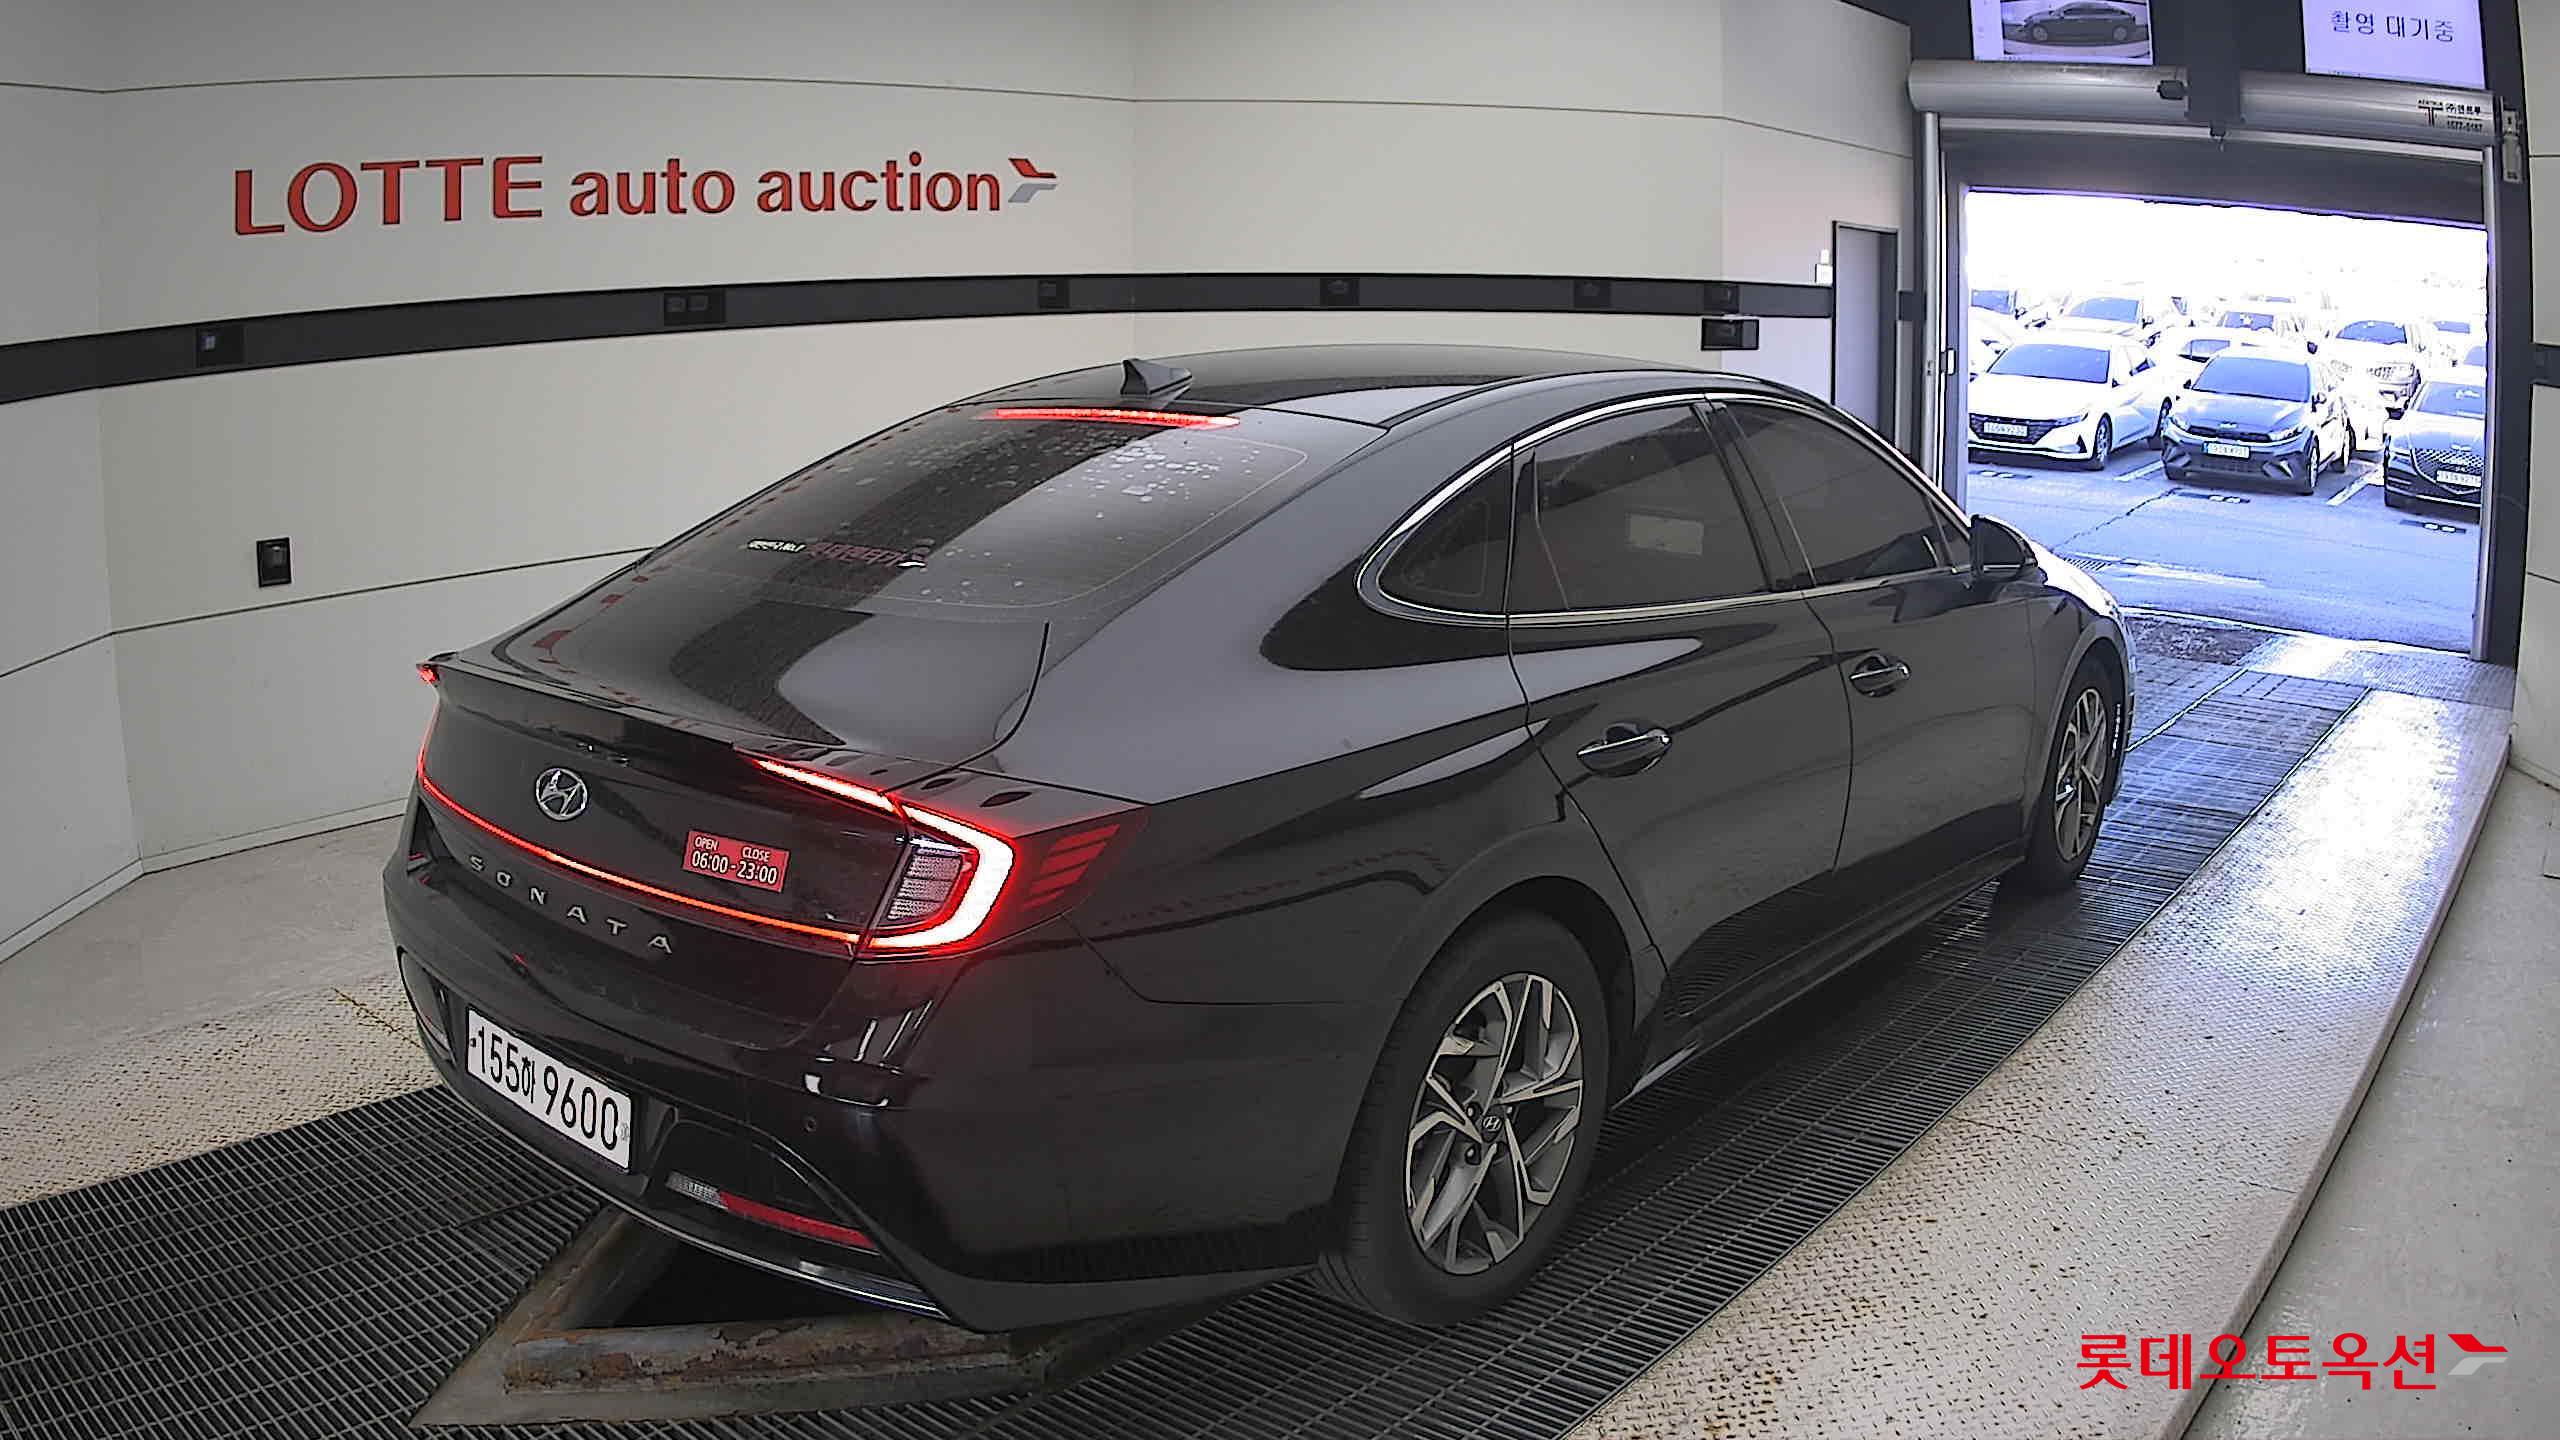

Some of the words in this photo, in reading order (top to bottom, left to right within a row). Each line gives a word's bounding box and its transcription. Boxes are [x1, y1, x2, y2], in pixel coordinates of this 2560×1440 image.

[2331, 10, 2375, 36] 촬영
[237, 155, 542, 235] LOTTE
[570, 159, 735, 216] auto
[758, 152, 1001, 213] auction
[694, 836, 719, 852] OPEN
[742, 846, 771, 863] CLOSE
[469, 855, 673, 955] SONATA
